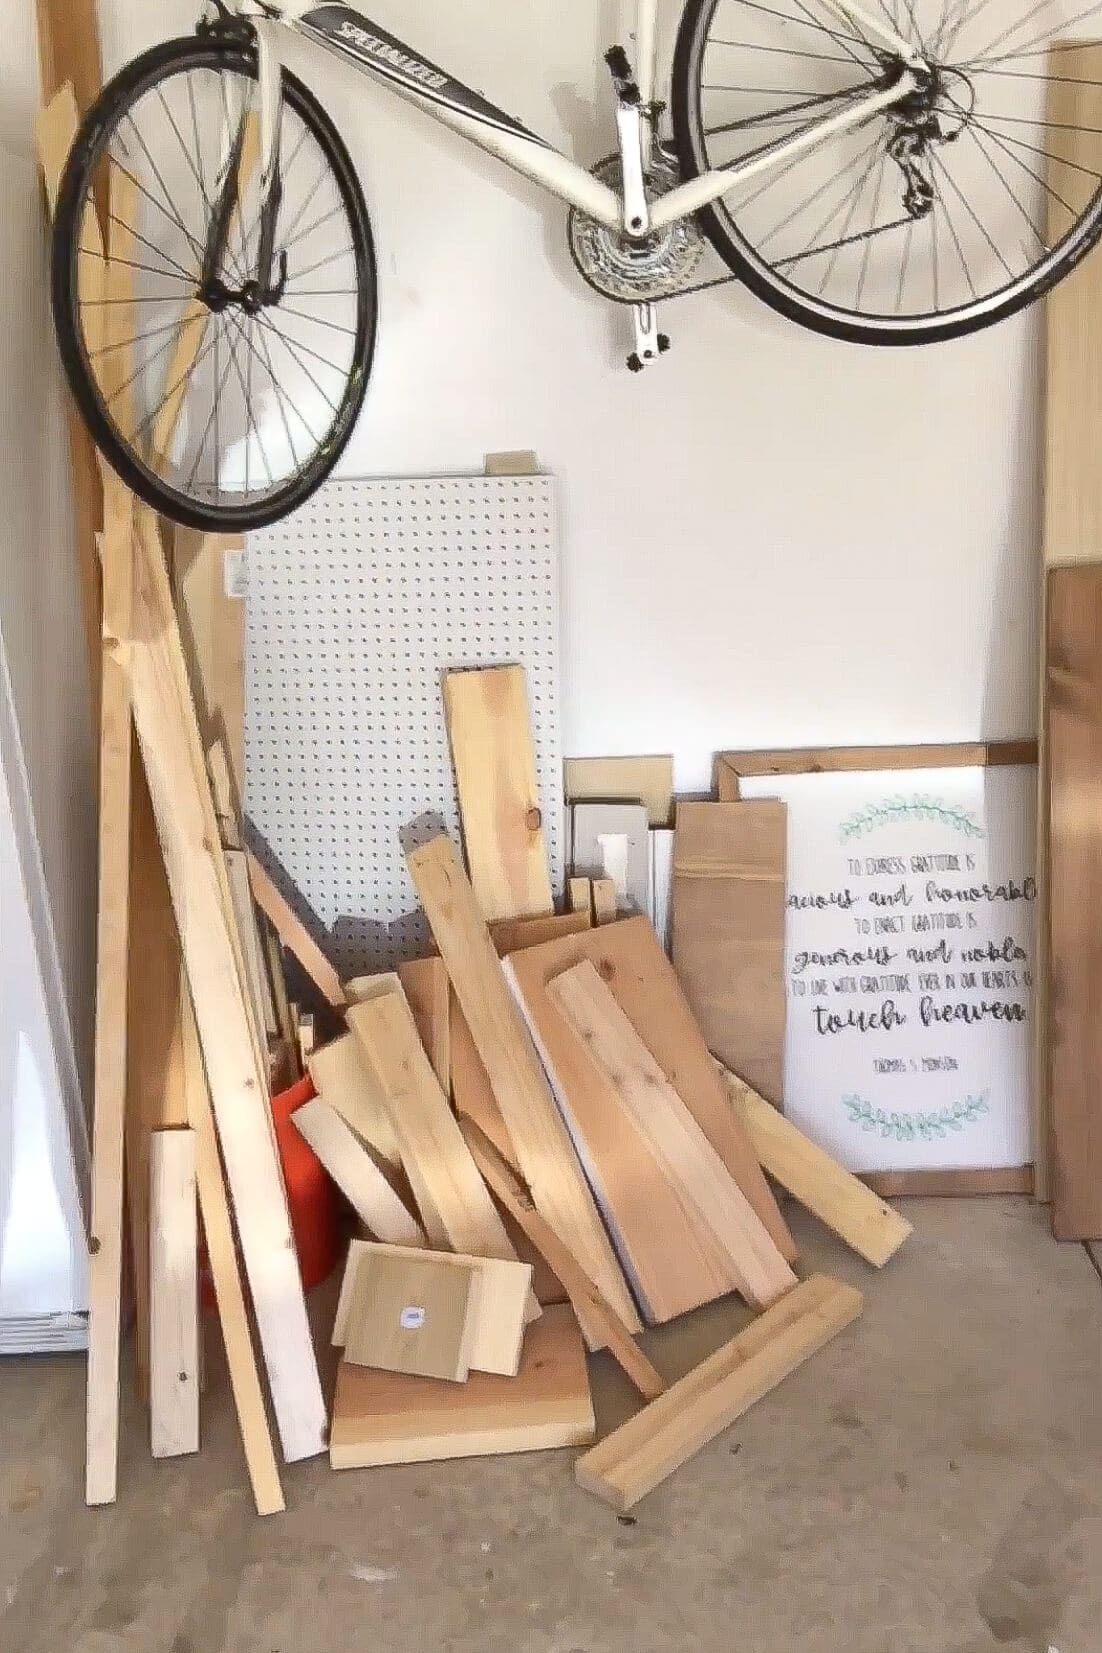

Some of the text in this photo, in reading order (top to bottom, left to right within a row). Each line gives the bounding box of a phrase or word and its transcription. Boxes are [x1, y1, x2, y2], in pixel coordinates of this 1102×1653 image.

[847, 857, 861, 876] TO
[785, 889, 857, 909] acious
[868, 882, 913, 906] and
[854, 917, 871, 935] TO
[791, 936, 1027, 974] generous and noble
[813, 995, 1027, 1035] touch heaven
